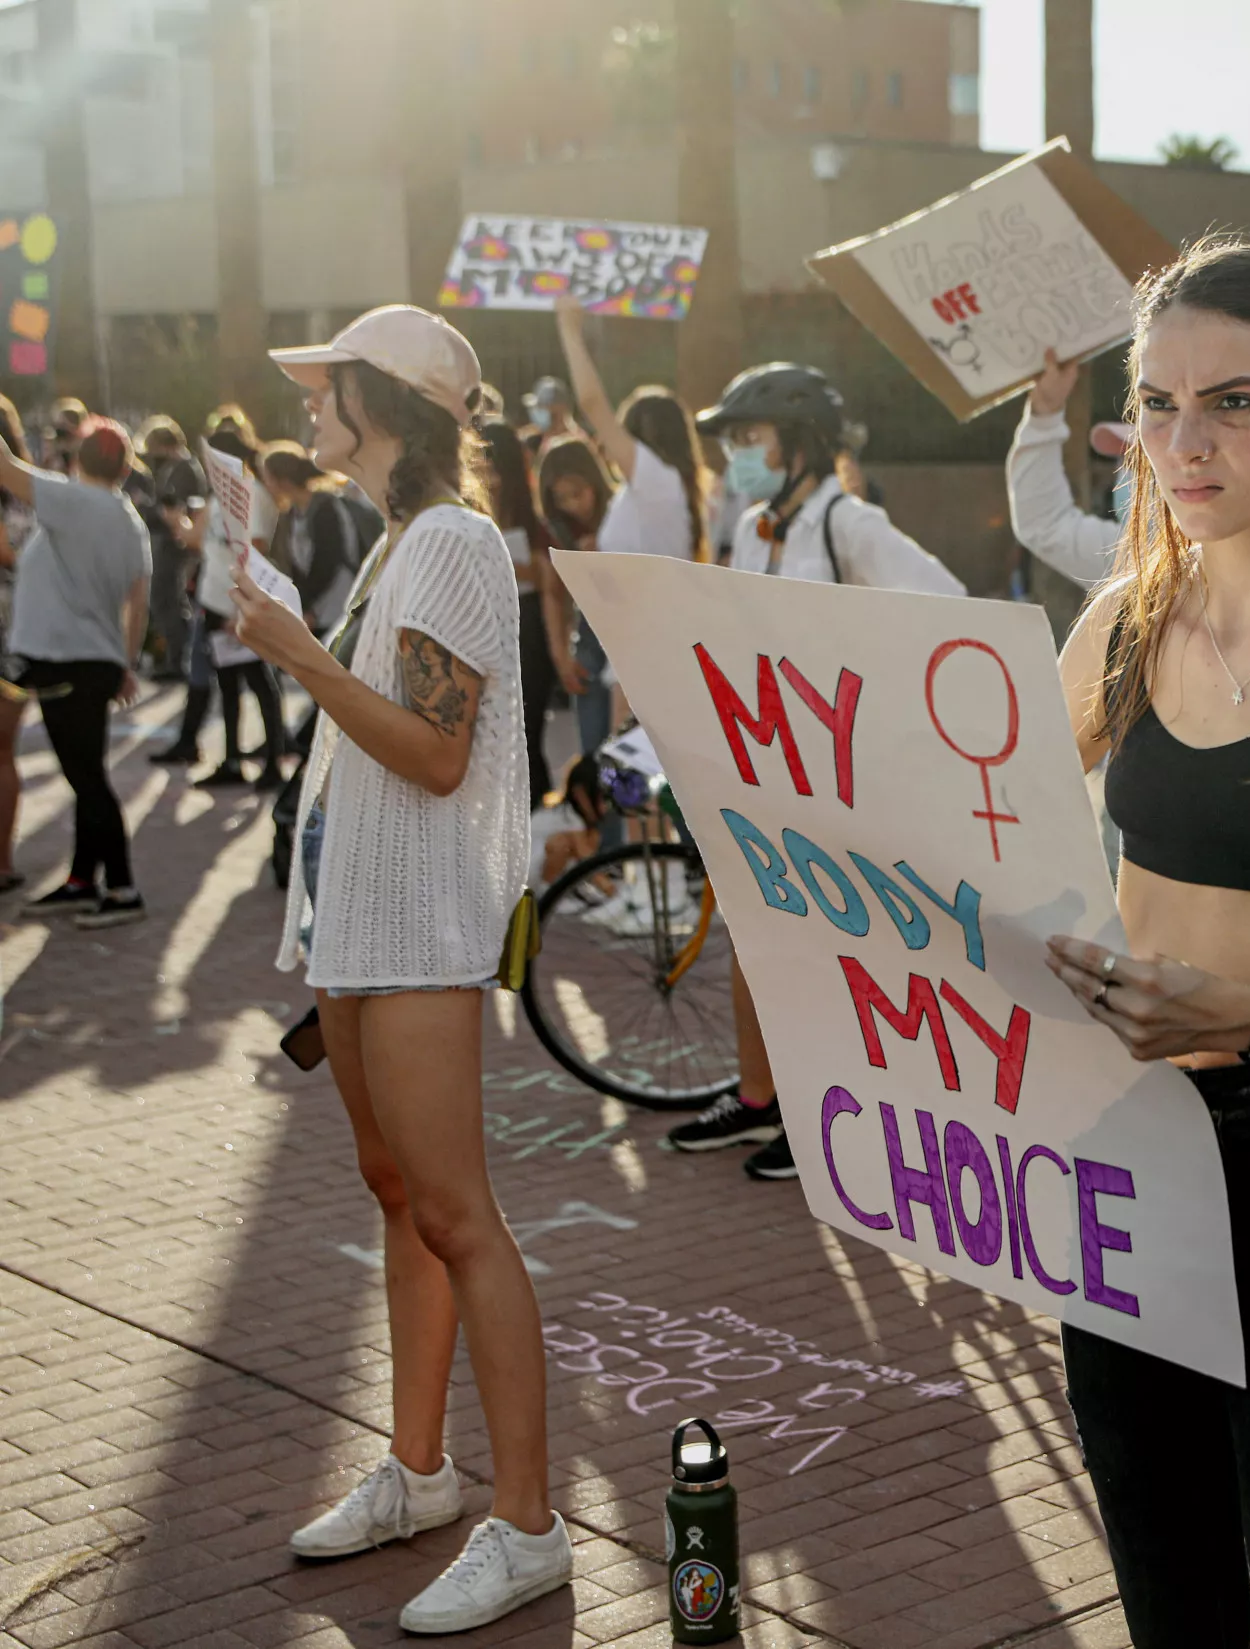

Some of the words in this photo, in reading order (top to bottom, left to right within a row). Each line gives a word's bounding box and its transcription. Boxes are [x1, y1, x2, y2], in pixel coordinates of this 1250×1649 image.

[930, 281, 983, 326] OFF
[692, 642, 863, 809] MY
[719, 808, 987, 972] BODY
[838, 955, 1031, 1116] MY
[821, 1086, 1141, 1319] CHOICE
